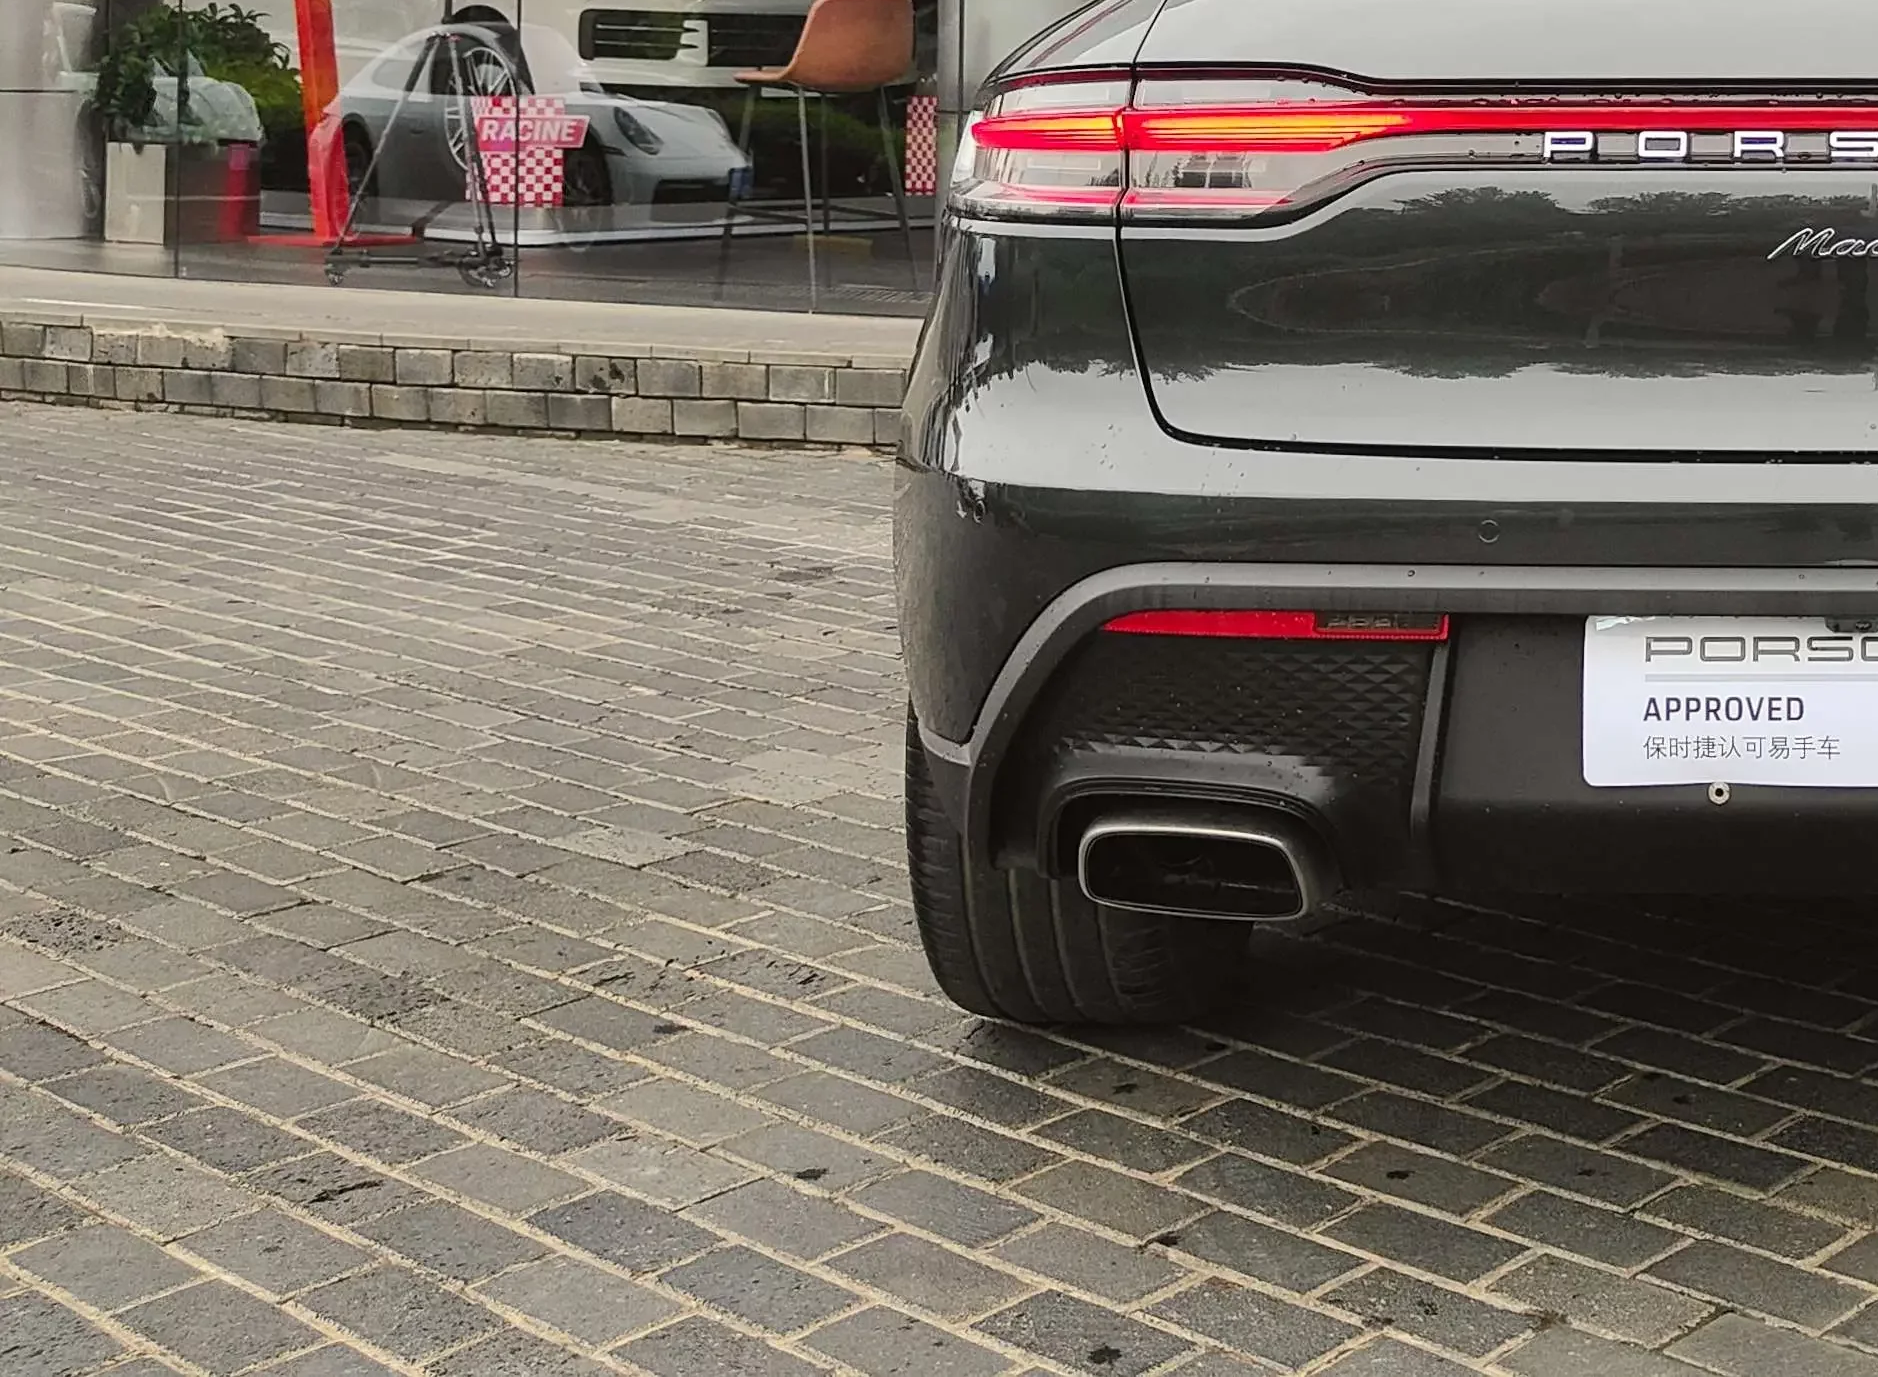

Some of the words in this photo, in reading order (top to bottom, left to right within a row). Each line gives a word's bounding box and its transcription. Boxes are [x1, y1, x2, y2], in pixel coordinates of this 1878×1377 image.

[1643, 696, 1806, 722] APPROVED
[1643, 735, 1841, 761] 保时捷认可易手车
